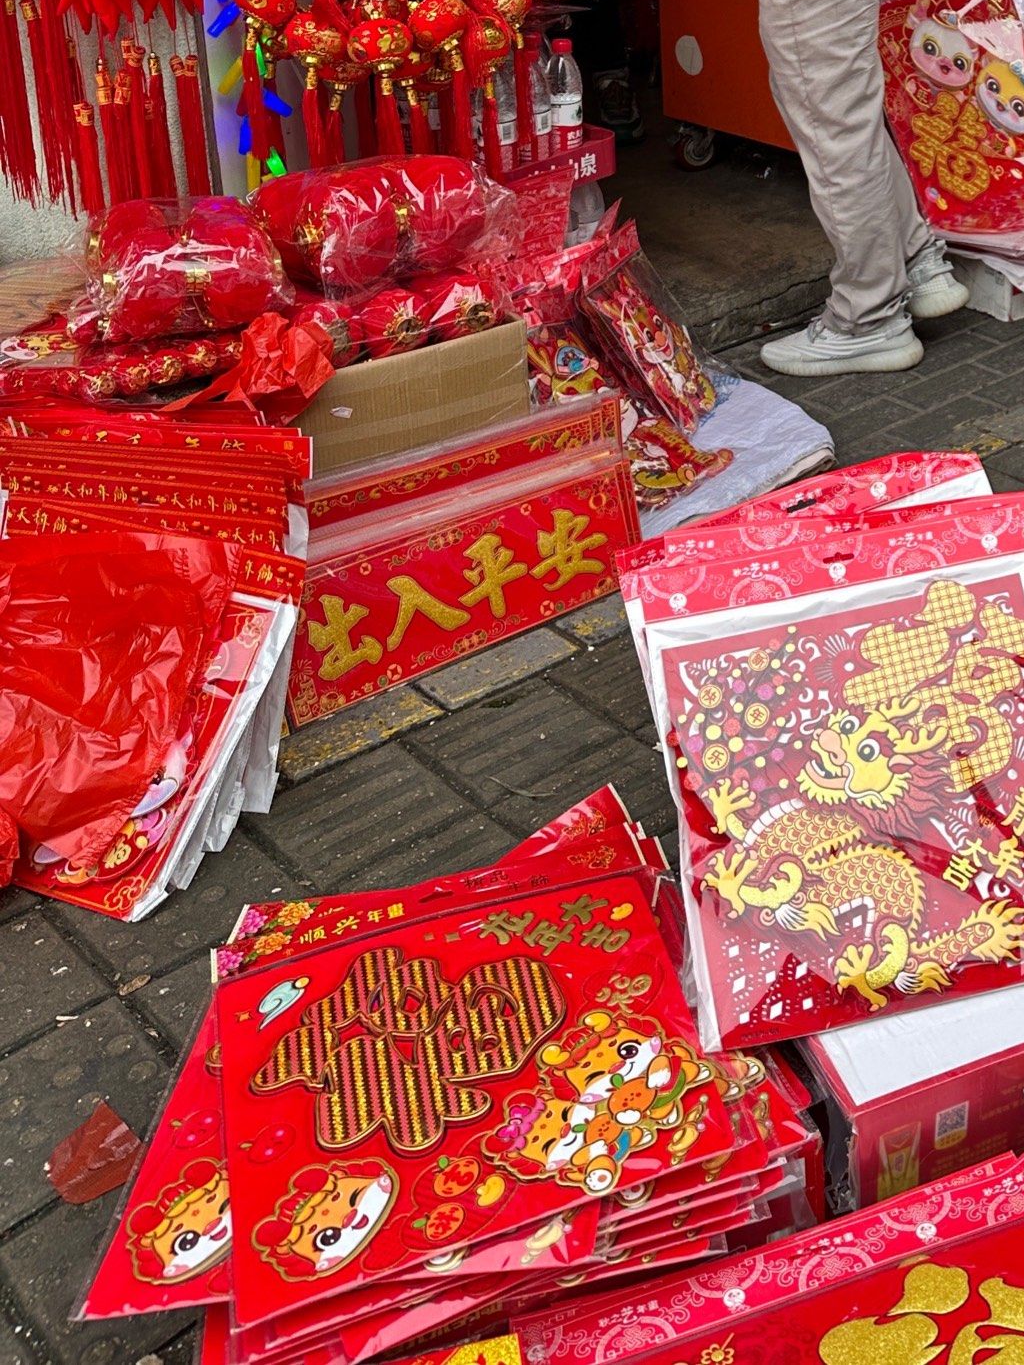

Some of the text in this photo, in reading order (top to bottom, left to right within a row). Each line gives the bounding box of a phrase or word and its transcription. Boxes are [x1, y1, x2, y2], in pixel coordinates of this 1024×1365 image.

[909, 91, 991, 201] 福
[307, 508, 608, 681] 出入平安
[351, 682, 374, 699] 大吉
[942, 838, 988, 892] 大吉
